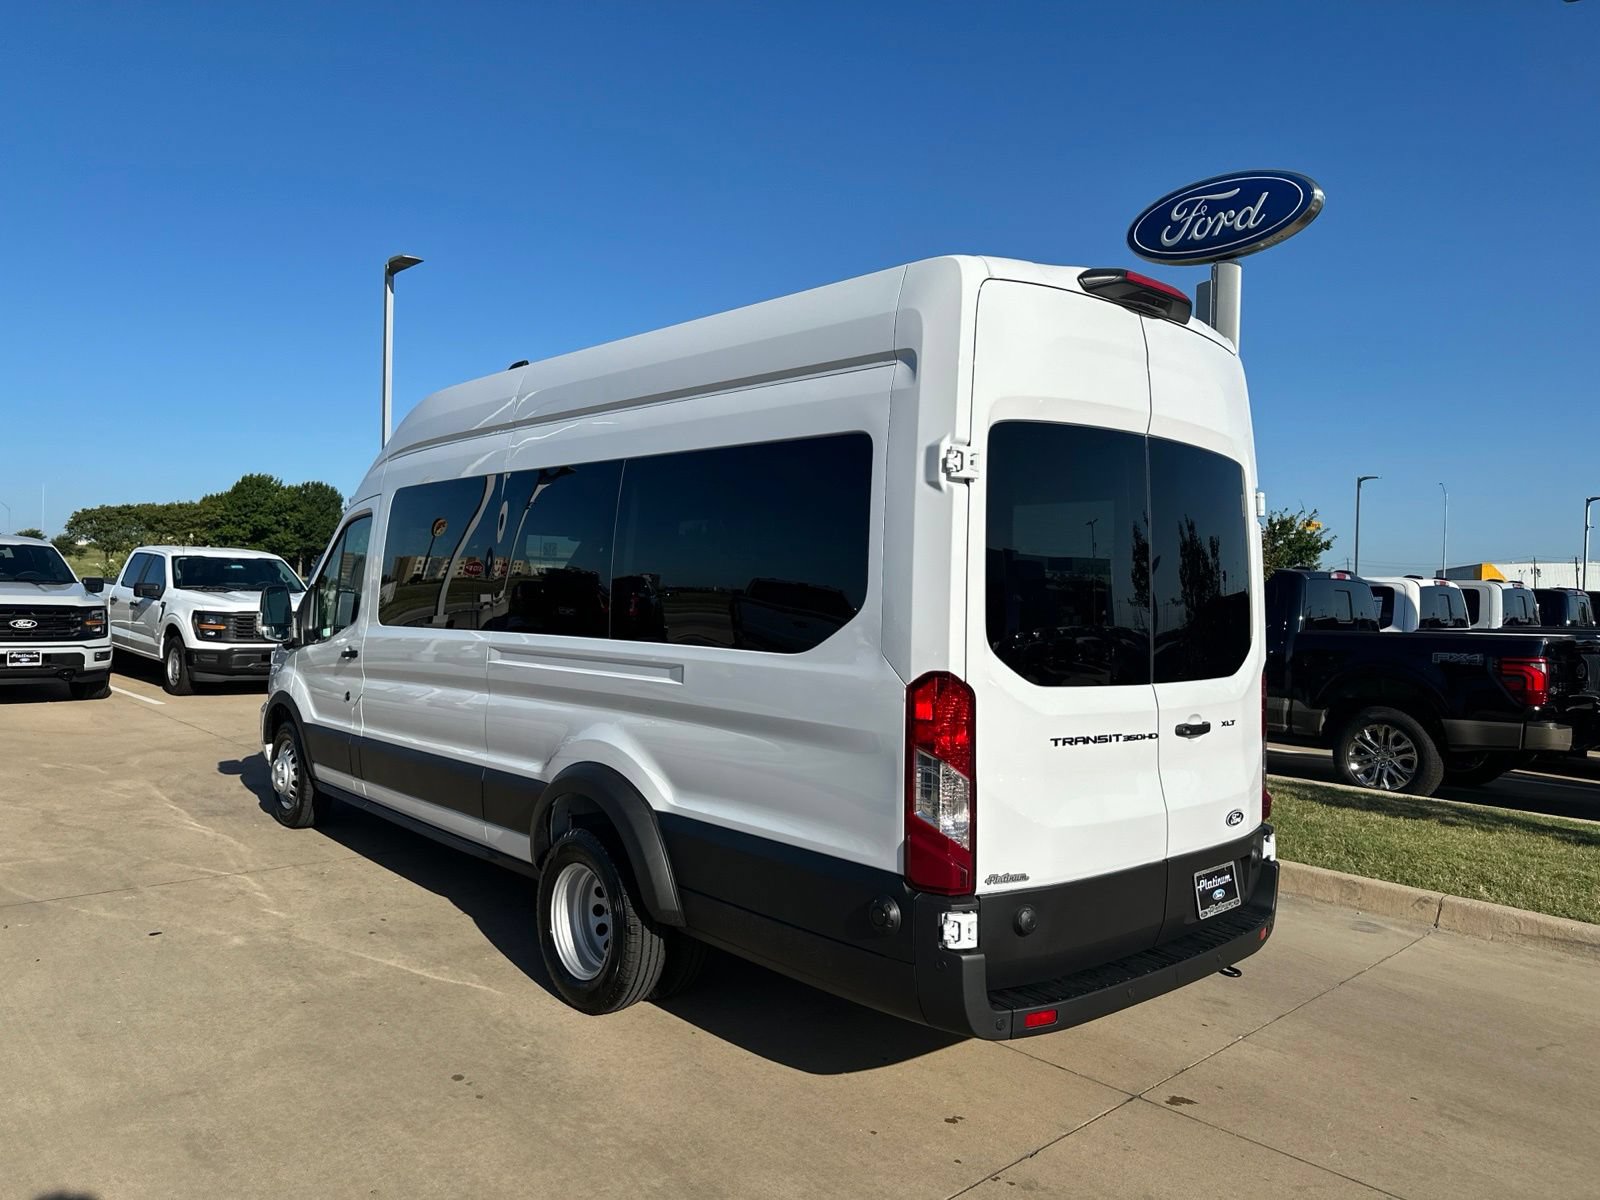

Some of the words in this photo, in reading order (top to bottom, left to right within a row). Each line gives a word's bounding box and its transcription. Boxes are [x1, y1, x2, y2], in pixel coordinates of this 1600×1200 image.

[1160, 187, 1269, 247] Ford
[1432, 652, 1484, 664] FX4
[1221, 719, 1236, 727] XLT
[1050, 734, 1122, 747] TRANSIT
[985, 872, 1030, 885] Platinum
[1197, 874, 1232, 892] Platinum
